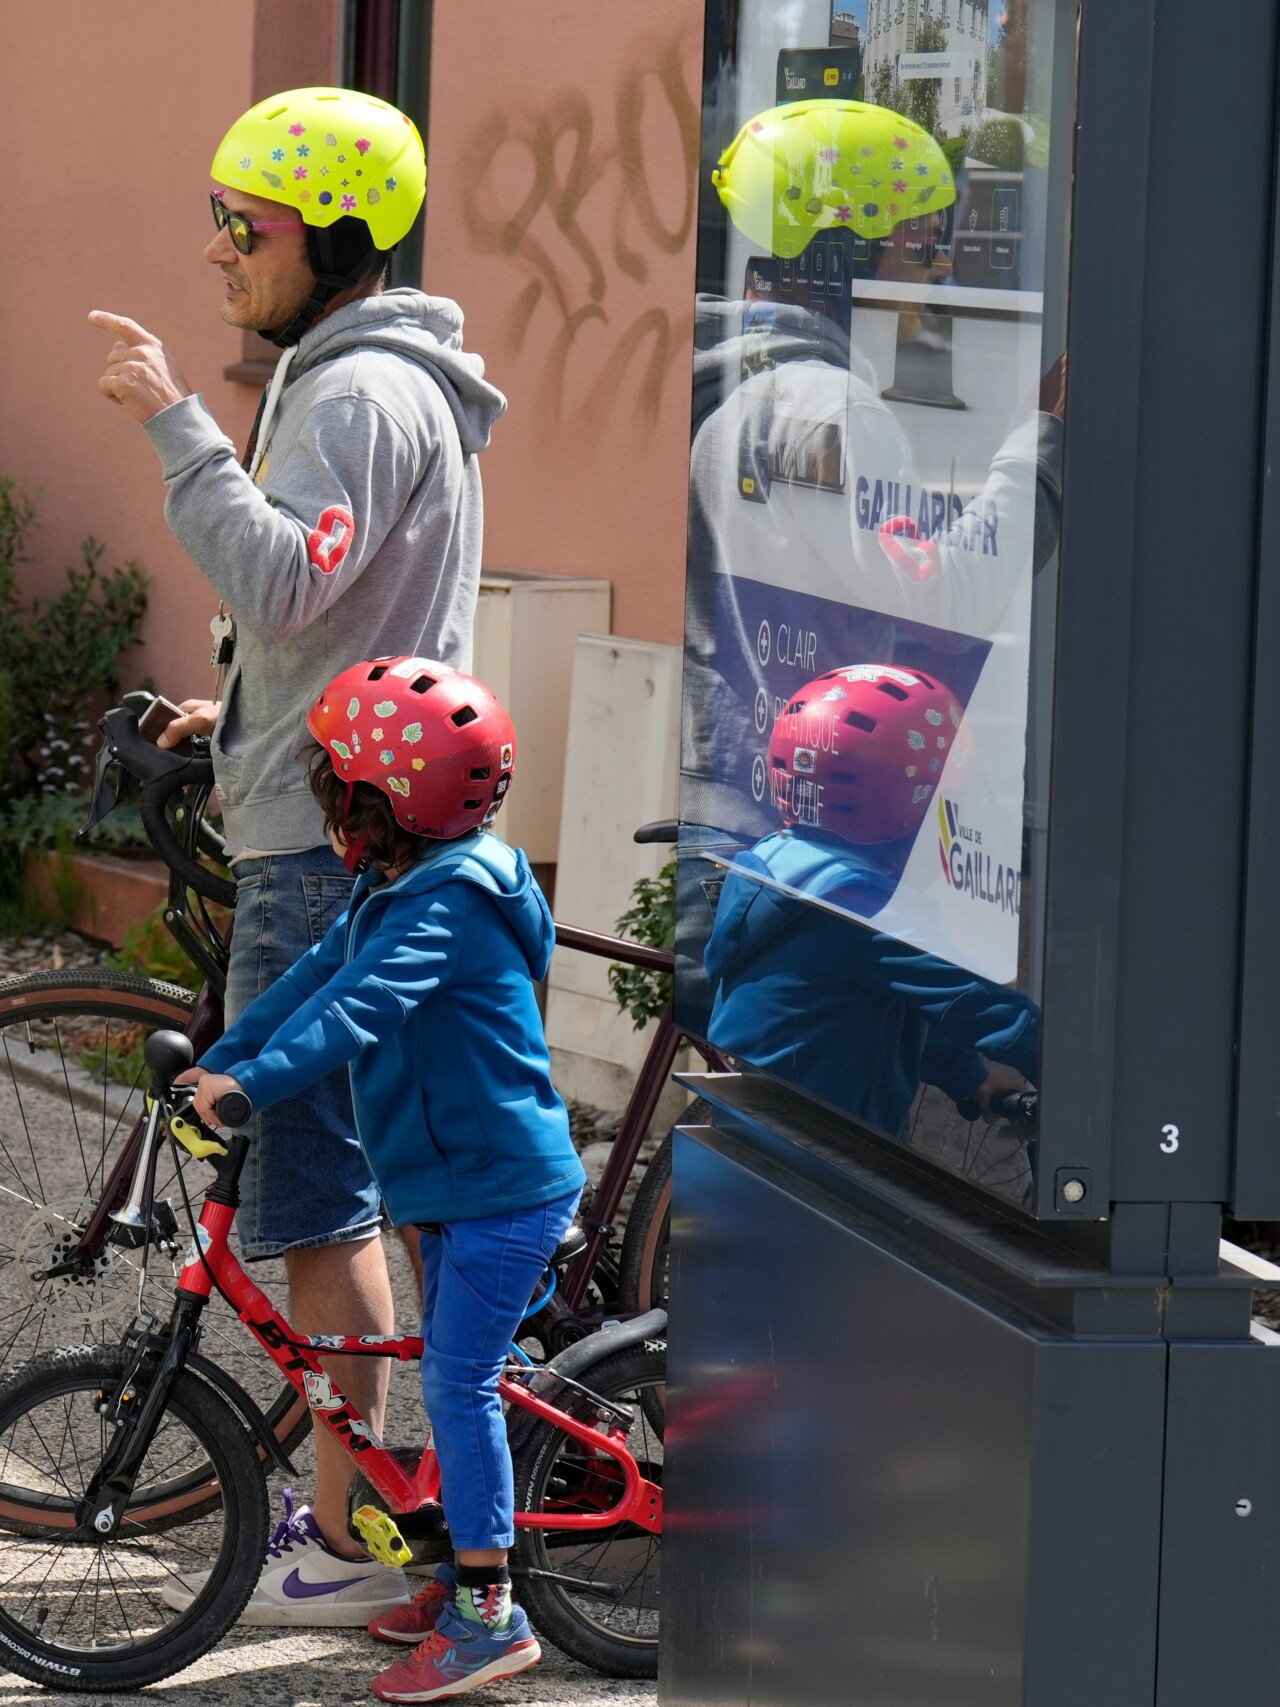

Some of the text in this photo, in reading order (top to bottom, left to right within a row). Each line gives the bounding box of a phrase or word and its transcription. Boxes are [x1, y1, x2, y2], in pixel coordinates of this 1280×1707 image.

[777, 624, 817, 672] CLAIR
[773, 696, 841, 755] PRATIQUE
[770, 767, 825, 823] INTUITIF
[959, 825, 982, 844] VILLE DE
[1159, 1123, 1179, 1153] 3
